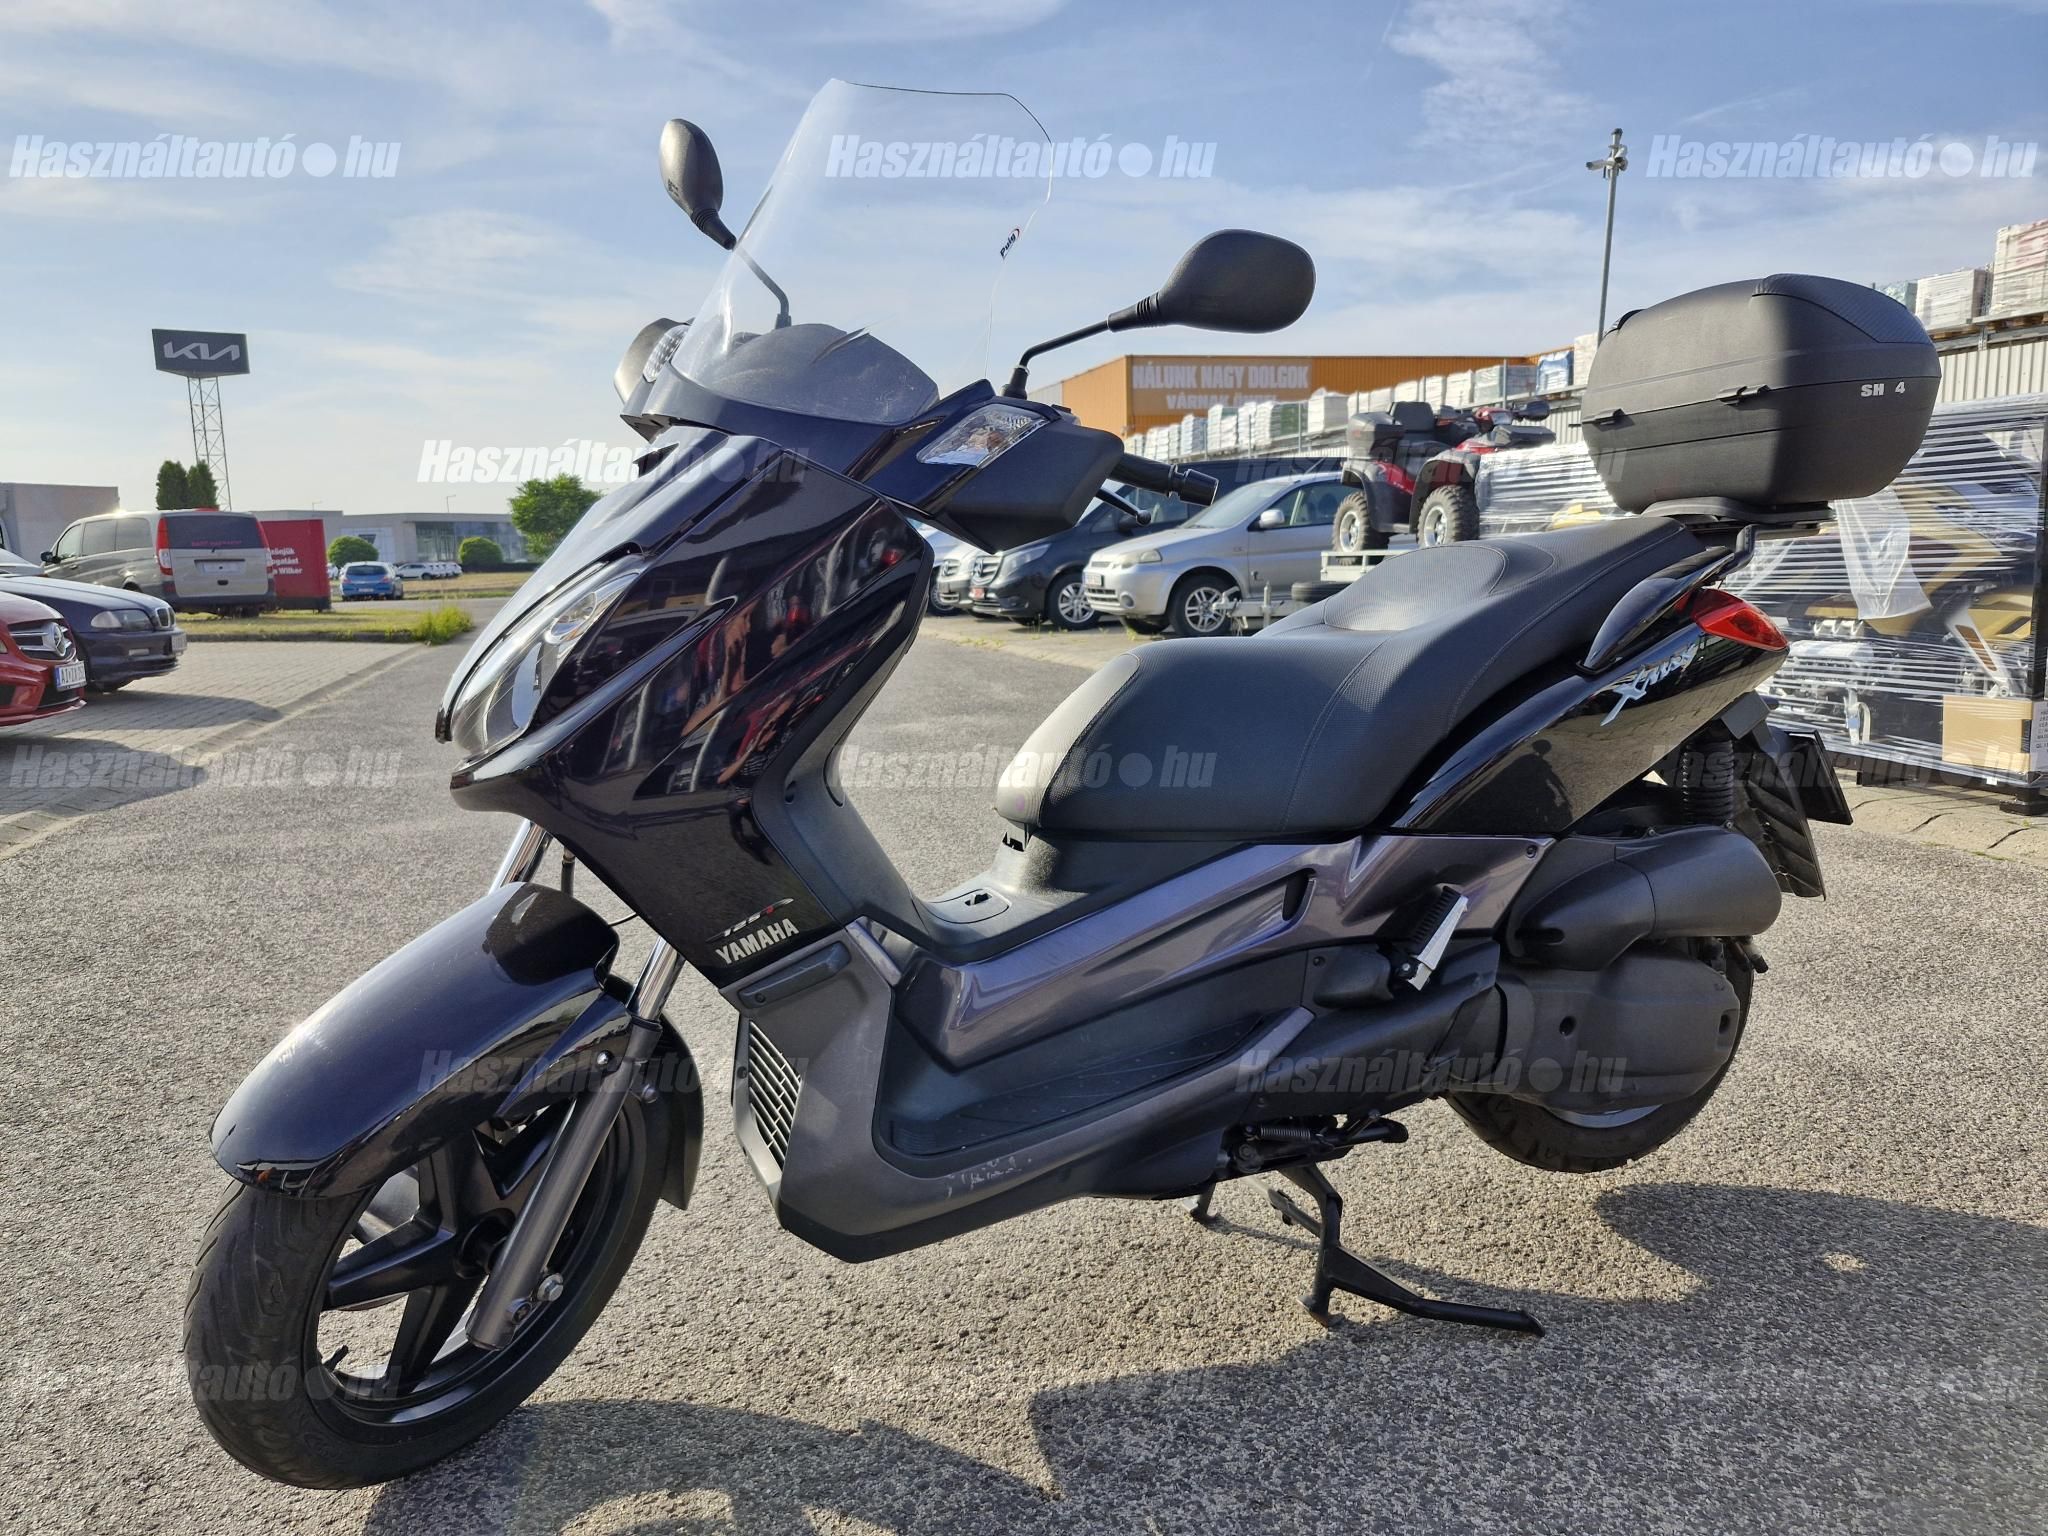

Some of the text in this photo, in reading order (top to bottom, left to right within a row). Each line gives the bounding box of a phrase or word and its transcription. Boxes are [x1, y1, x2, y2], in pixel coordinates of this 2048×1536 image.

[1201, 365, 1245, 389] NAGY
[1248, 365, 1309, 389] DOLGOK
[1860, 383, 1885, 397] SH
[715, 918, 800, 965] YAMAHA
